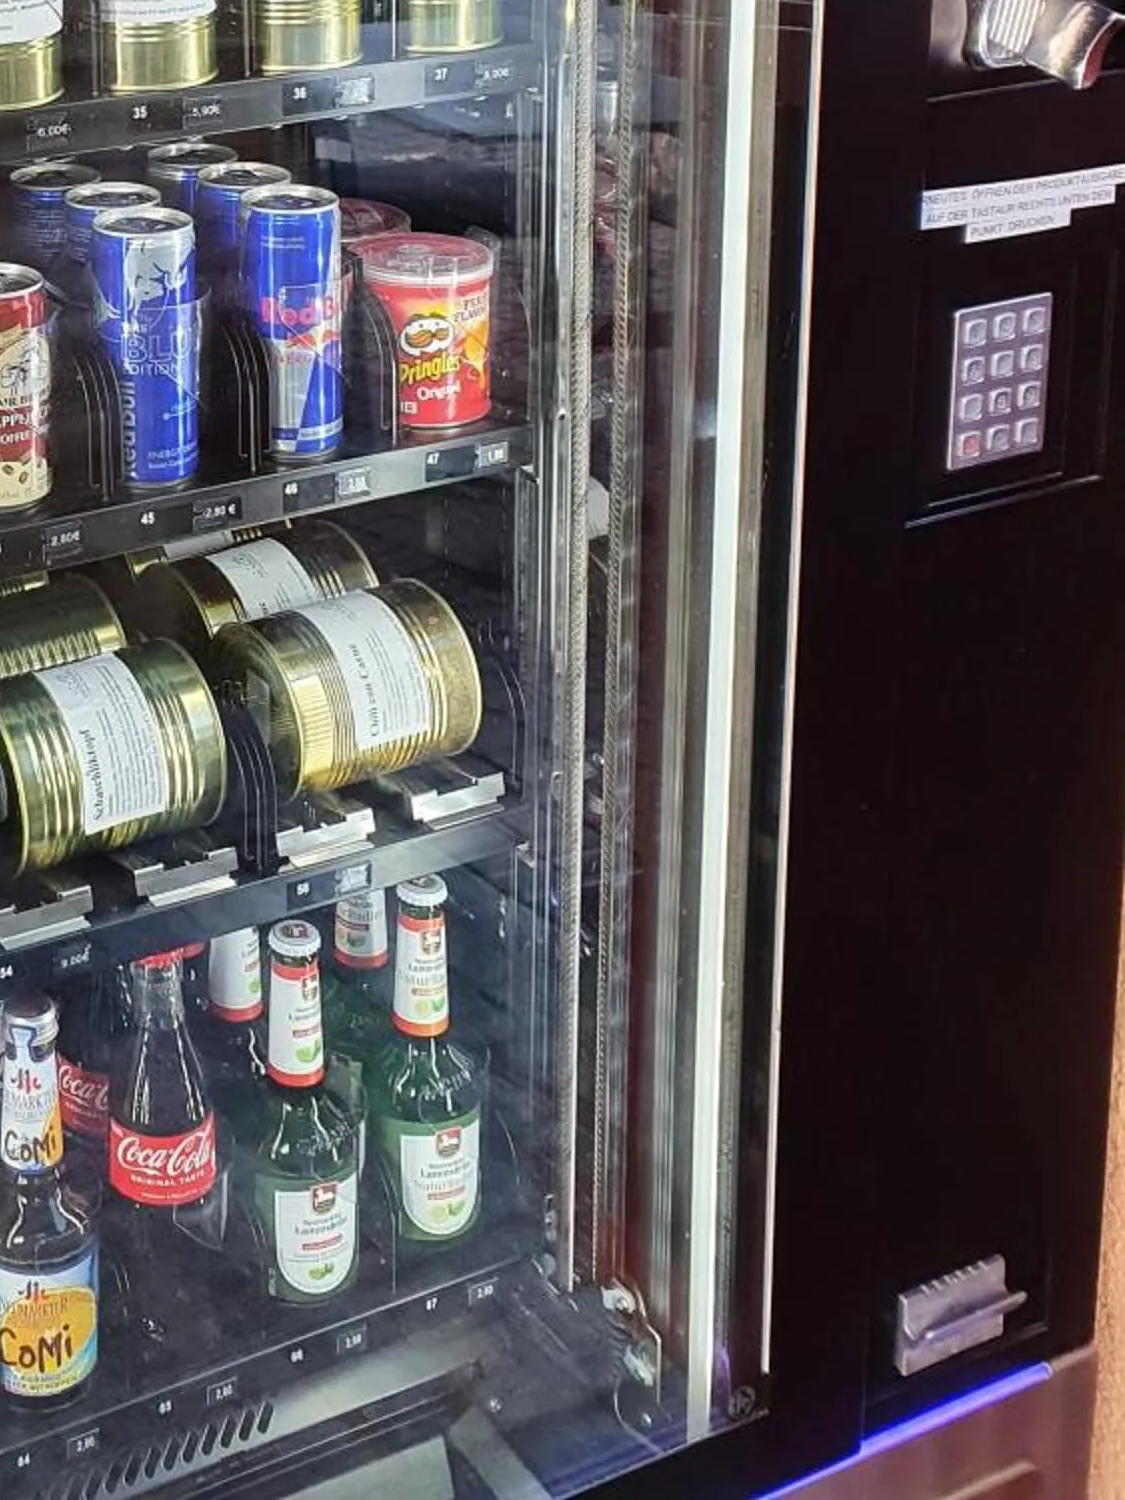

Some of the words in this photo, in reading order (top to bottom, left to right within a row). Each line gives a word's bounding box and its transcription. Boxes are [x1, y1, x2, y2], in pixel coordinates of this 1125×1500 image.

[434, 67, 448, 81] 37
[132, 105, 148, 119] 35
[121, 331, 191, 363] BLU
[401, 354, 462, 384] Pringles
[426, 452, 440, 465] 47
[284, 482, 298, 495] 46
[140, 511, 155, 525] 45
[0, 965, 13, 979] 54
[118, 1132, 216, 1178] Coca-Cola
